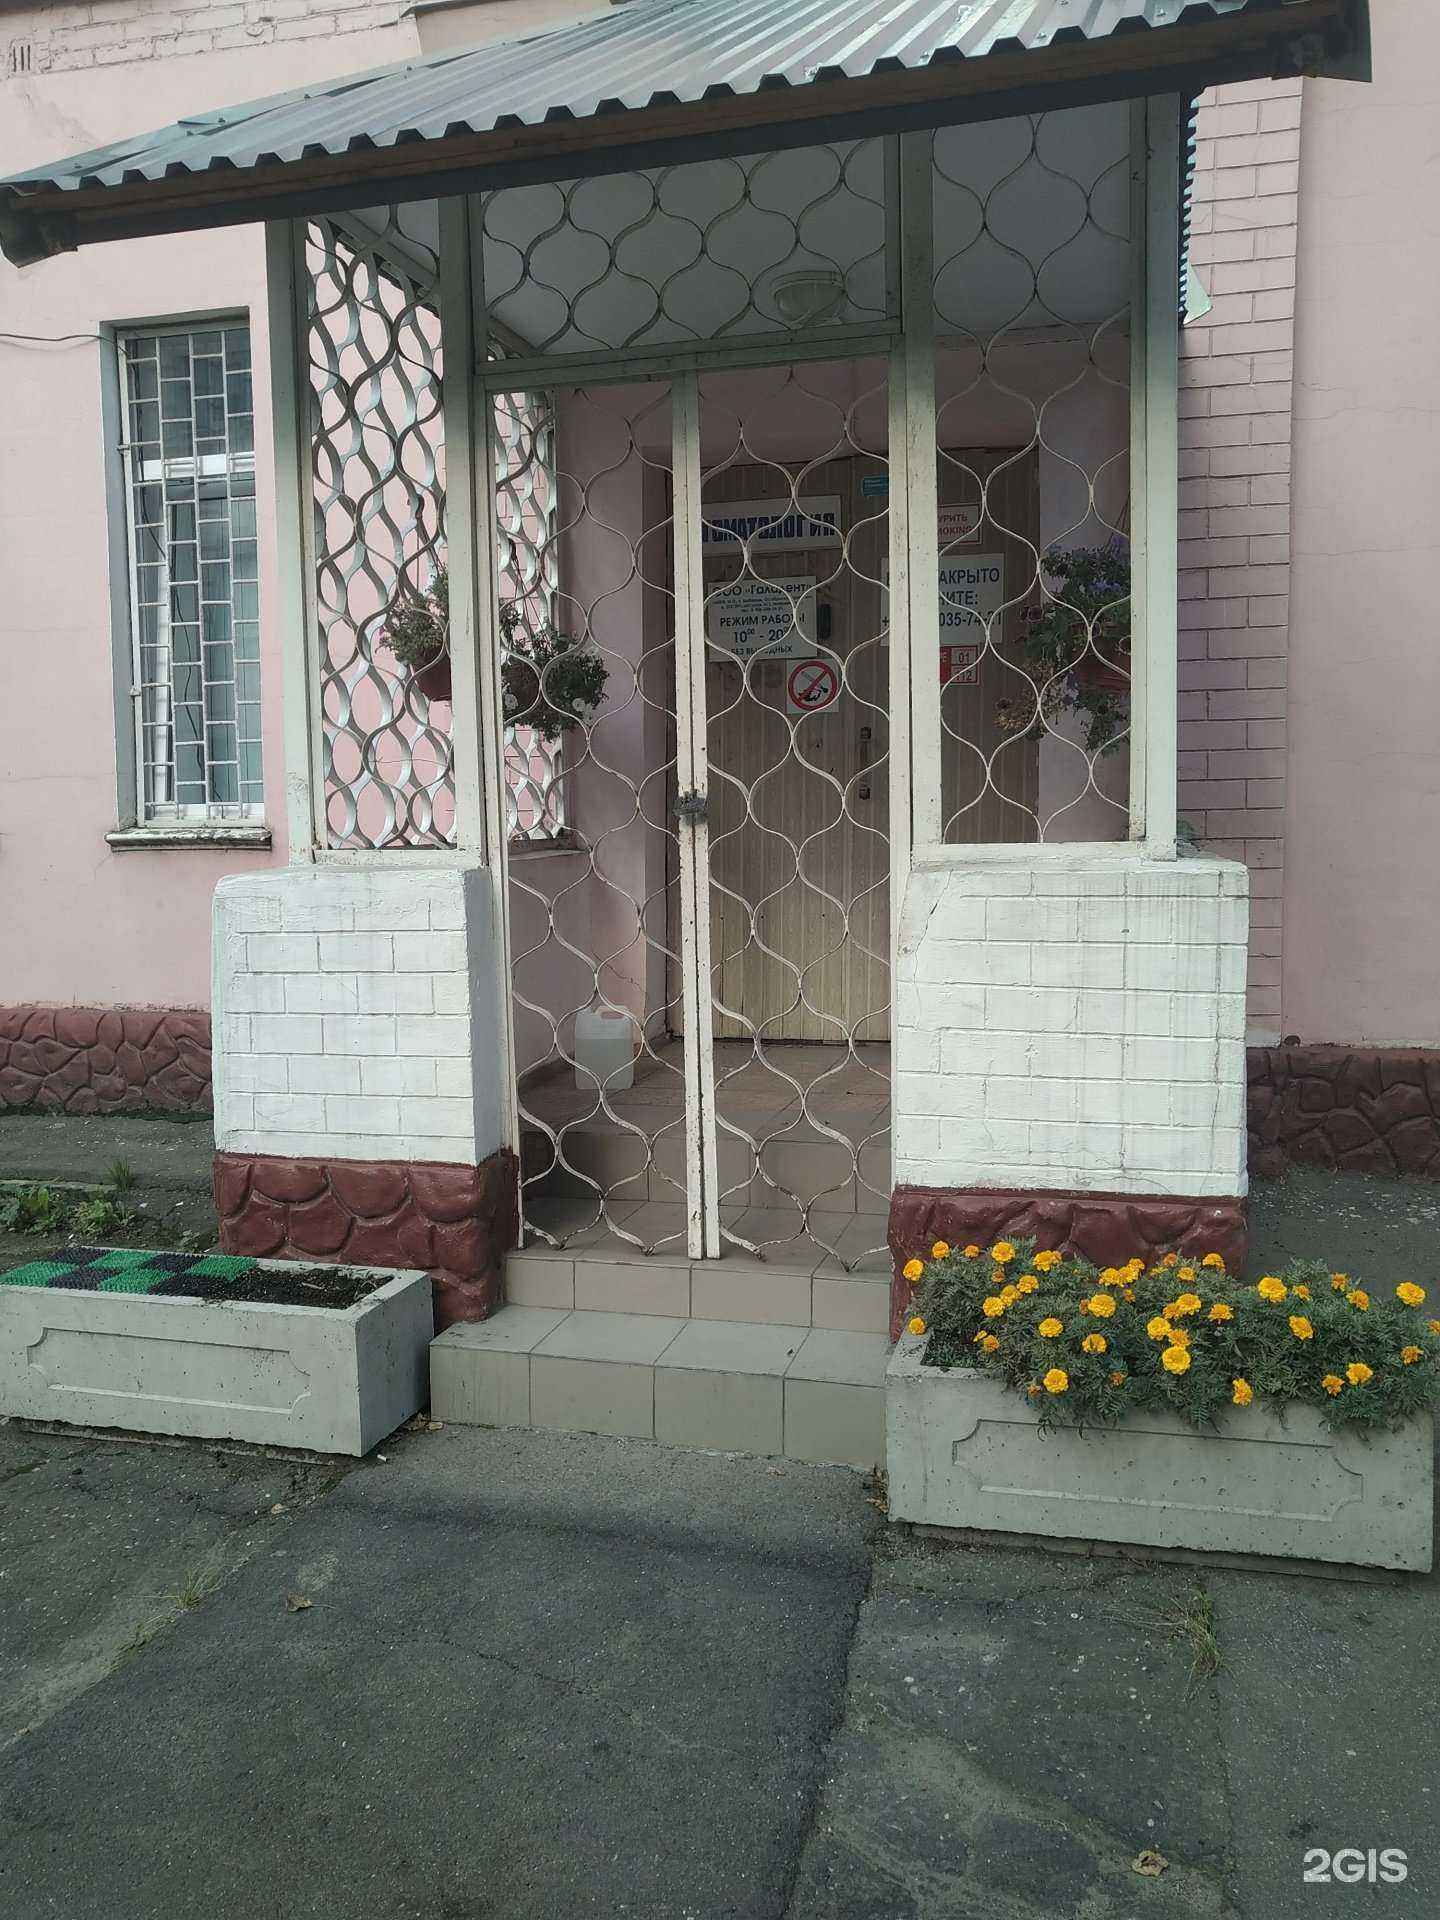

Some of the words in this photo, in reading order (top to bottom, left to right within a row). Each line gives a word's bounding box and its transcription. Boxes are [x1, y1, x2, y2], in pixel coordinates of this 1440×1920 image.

[702, 513, 835, 542] ТОМАТОЛОГИЯ
[938, 567, 1000, 584] АКРЫТО
[720, 615, 759, 627] РЕЖИМ
[761, 613, 805, 625] РАБОЫ
